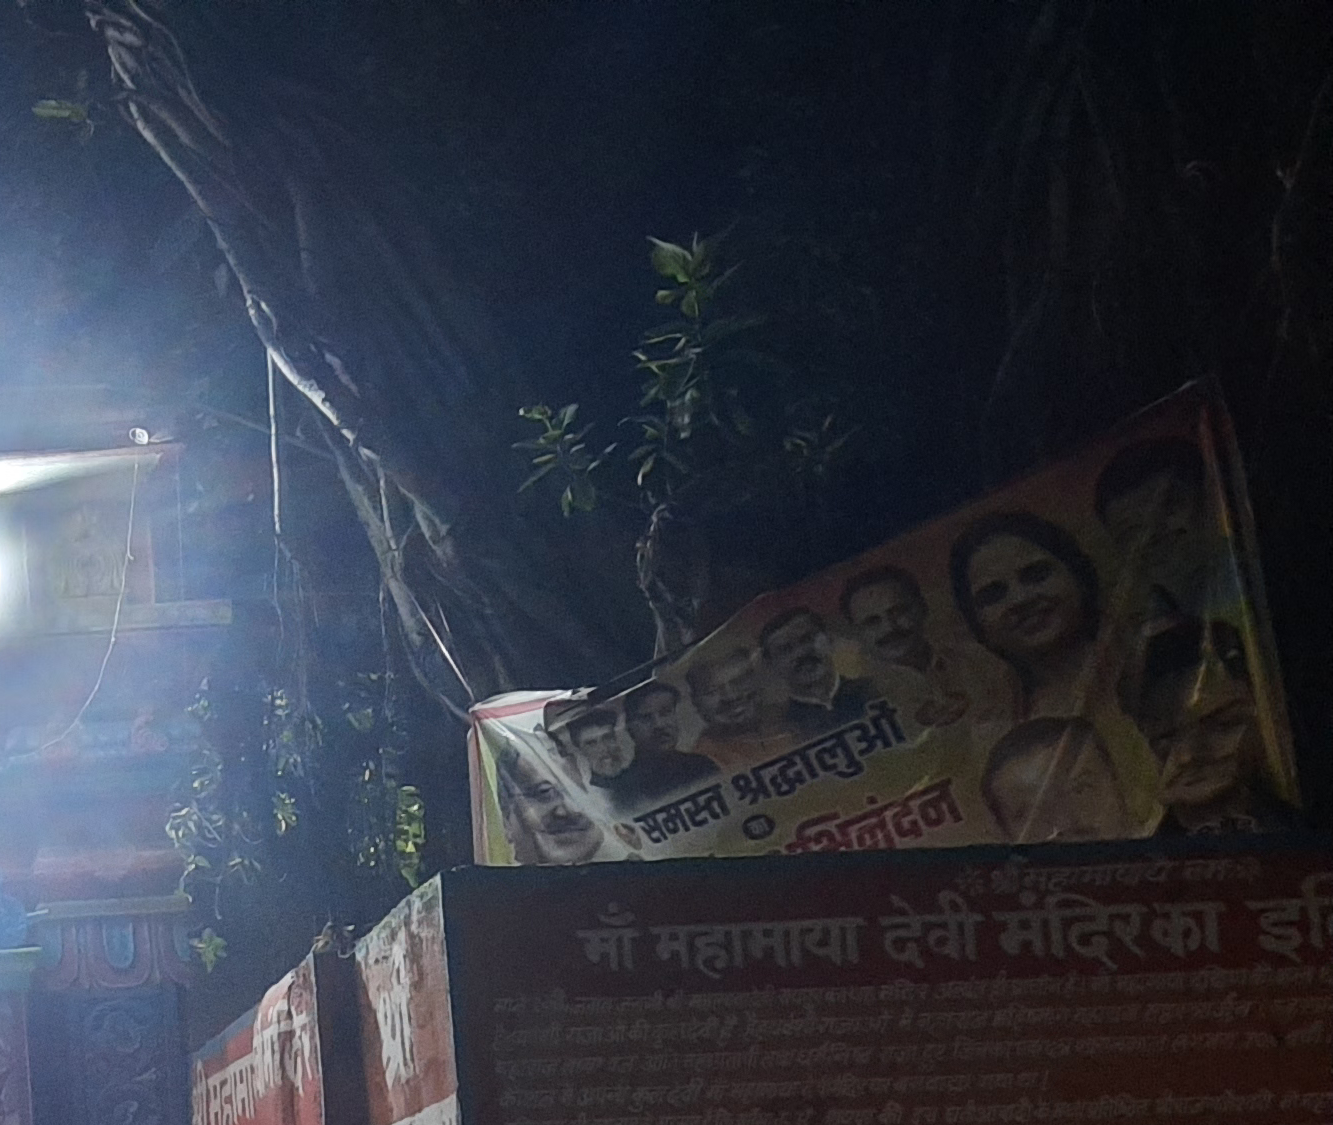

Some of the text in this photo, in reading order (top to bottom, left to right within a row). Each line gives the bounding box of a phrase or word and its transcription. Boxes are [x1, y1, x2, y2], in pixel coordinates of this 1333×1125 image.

[633, 779, 730, 845] समस्त
[576, 901, 642, 972] माँ
[649, 916, 869, 980] महामाया
[879, 891, 985, 968] देवी
[993, 890, 1149, 972] मंदिर
[1153, 900, 1229, 959] का
[376, 940, 419, 1091] श्री
